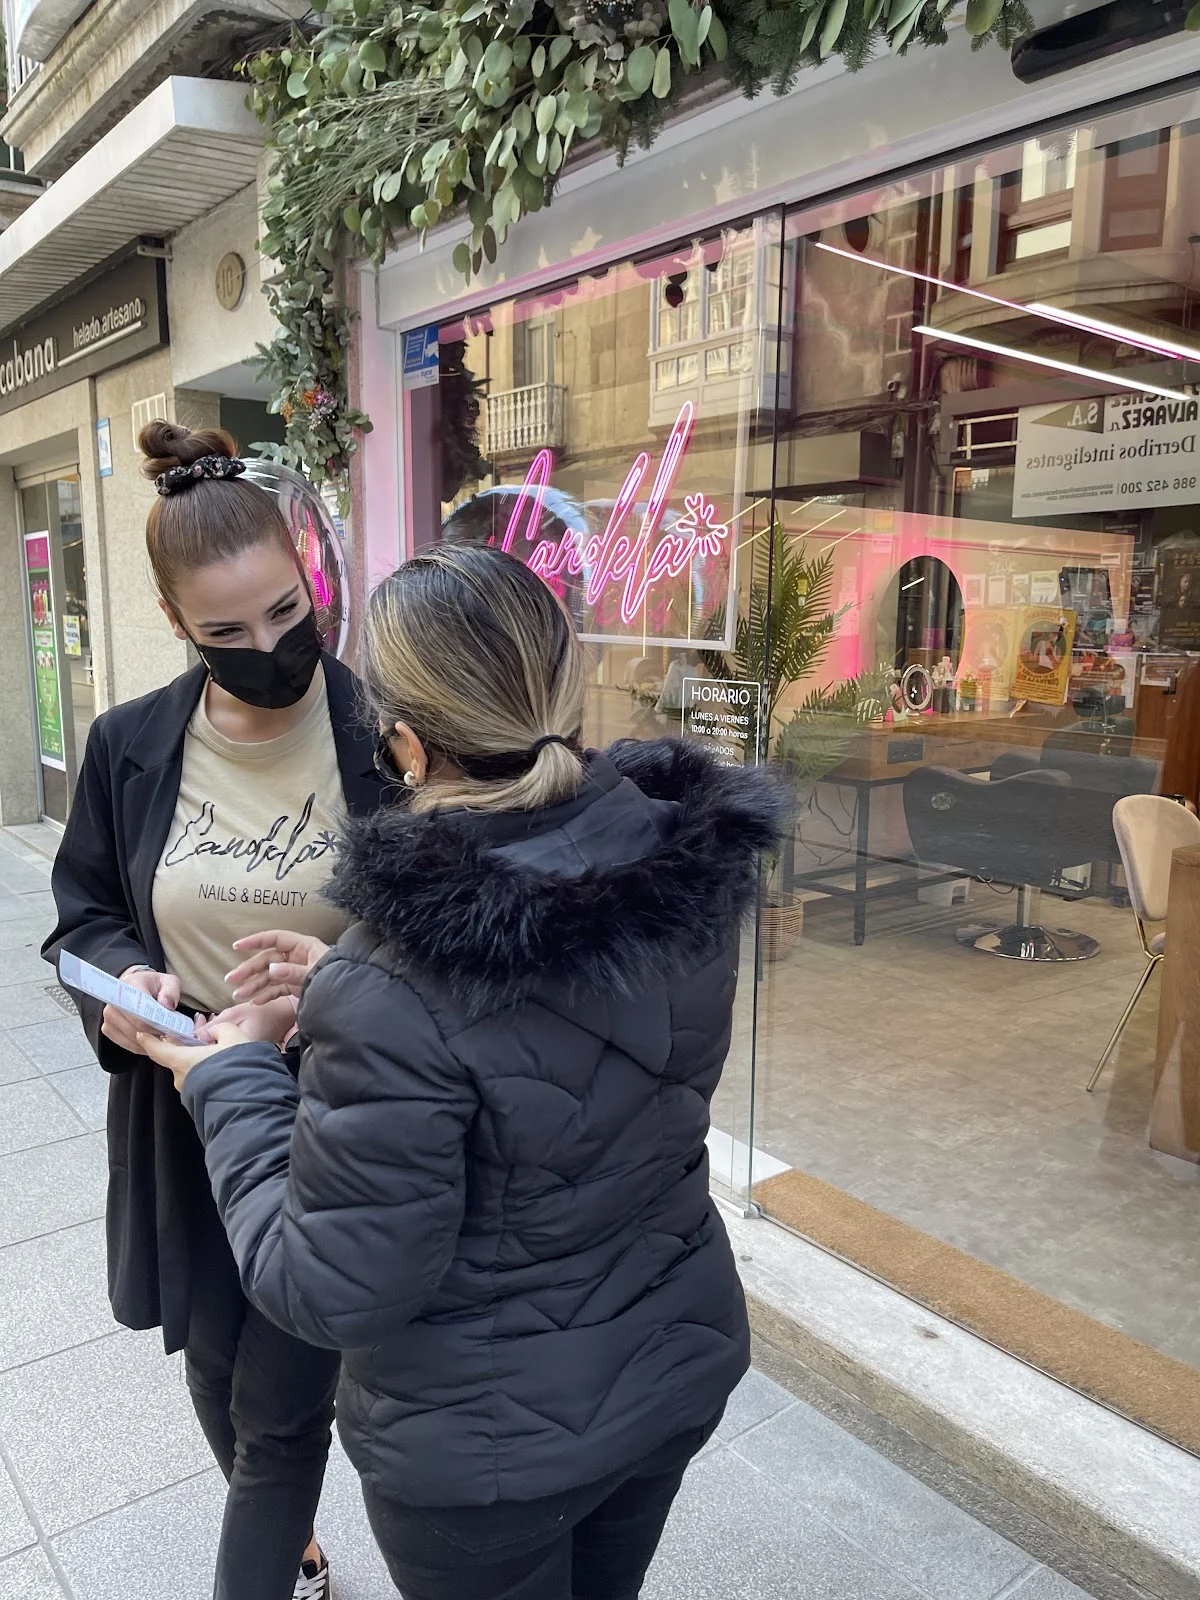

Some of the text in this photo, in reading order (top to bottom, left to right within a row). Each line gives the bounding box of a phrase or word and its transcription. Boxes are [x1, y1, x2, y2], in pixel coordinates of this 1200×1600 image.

[73, 297, 142, 349] helado artesano
[0, 336, 55, 396] cabana
[691, 685, 750, 705] HORARIO
[691, 711, 749, 725] LUNES A VIERNES
[691, 724, 706, 734] 10:00
[712, 727, 727, 737] 20:00
[728, 729, 748, 740] horas
[198, 883, 308, 907] NAILS & BEAUTY
